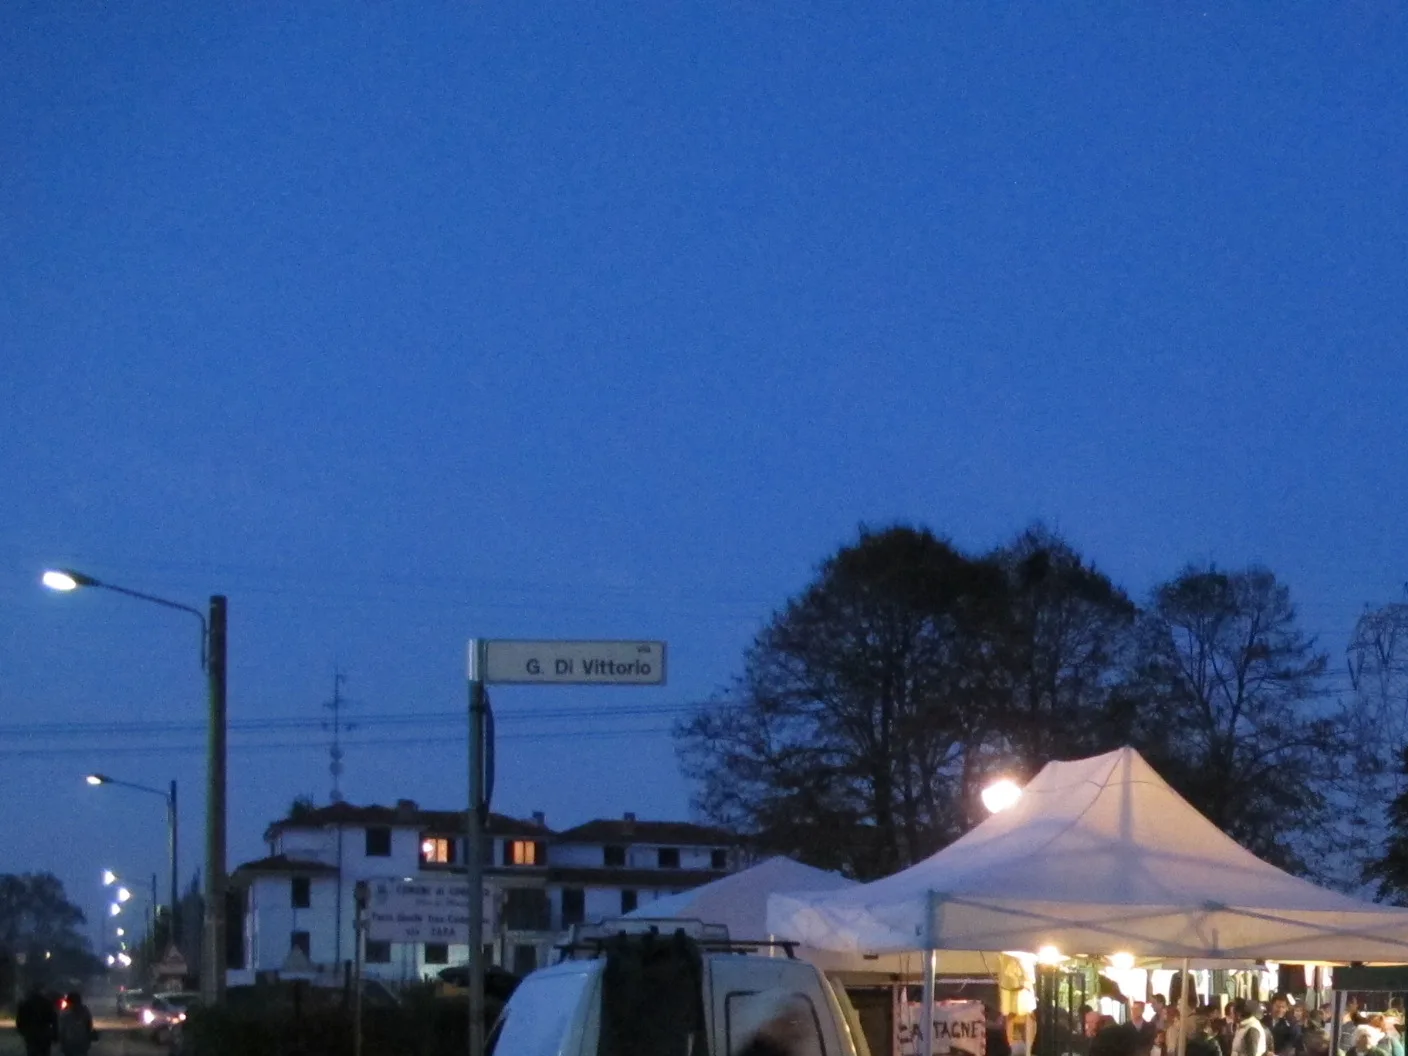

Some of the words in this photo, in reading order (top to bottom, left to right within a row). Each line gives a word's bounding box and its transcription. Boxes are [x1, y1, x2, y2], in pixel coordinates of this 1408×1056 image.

[554, 658, 574, 675] Di
[582, 658, 652, 676] Vittorio
[898, 1020, 981, 1044] CATAGNE
